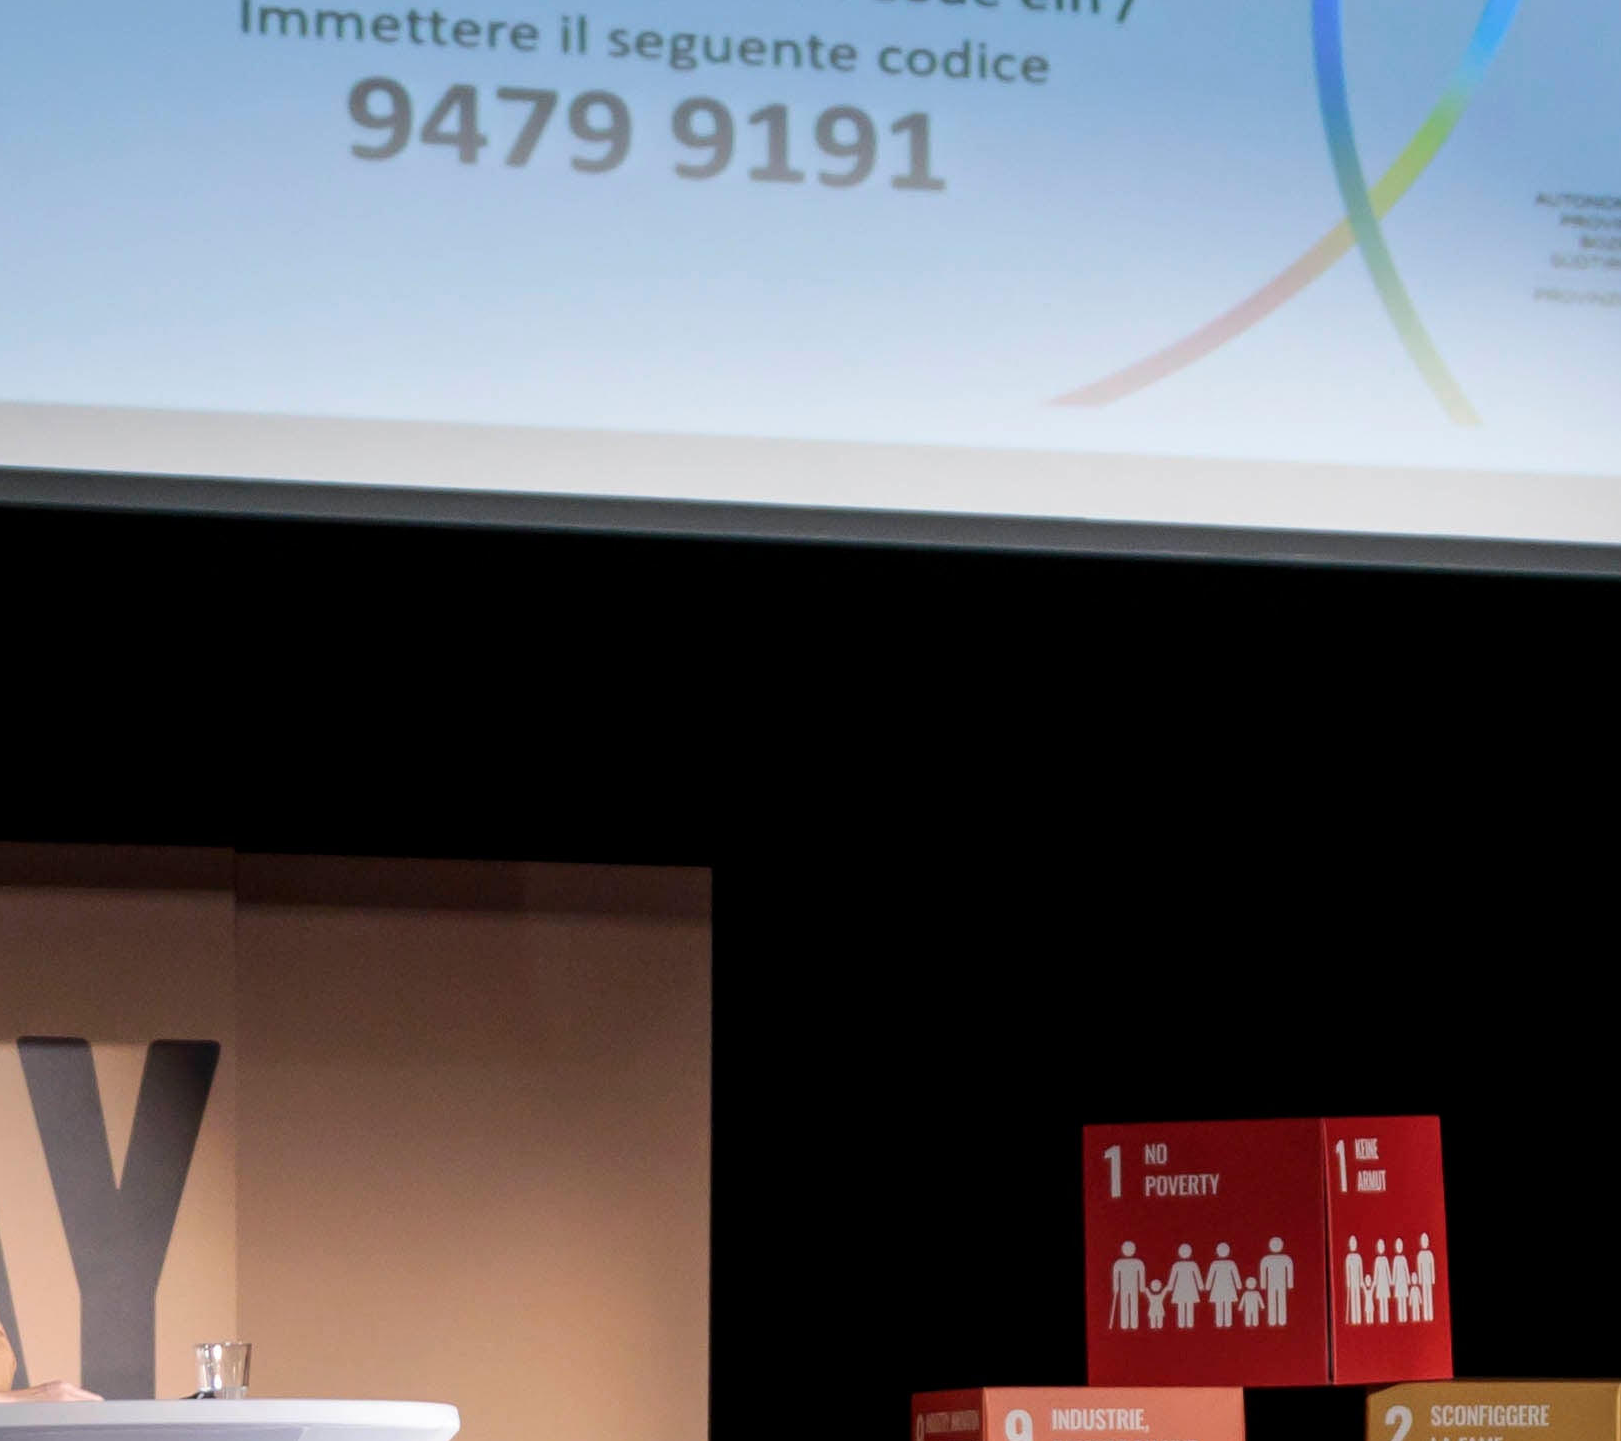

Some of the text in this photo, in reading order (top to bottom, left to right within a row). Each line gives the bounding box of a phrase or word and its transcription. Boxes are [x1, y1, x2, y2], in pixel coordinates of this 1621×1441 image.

[561, 14, 588, 55] il
[609, 23, 857, 73] seguente
[878, 39, 1051, 85] codice
[347, 75, 947, 192] 9479 9191
[1144, 1144, 1168, 1164] NO
[1355, 1138, 1379, 1160] KEINE
[1104, 1145, 1122, 1198] 1
[1335, 1139, 1348, 1192] 1
[1144, 1173, 1219, 1197] POVERTY
[1357, 1170, 1386, 1191] ARMUT
[1052, 1409, 1149, 1433] INDUSTRIE,
[1431, 1404, 1550, 1427] SCONFIGGERE
